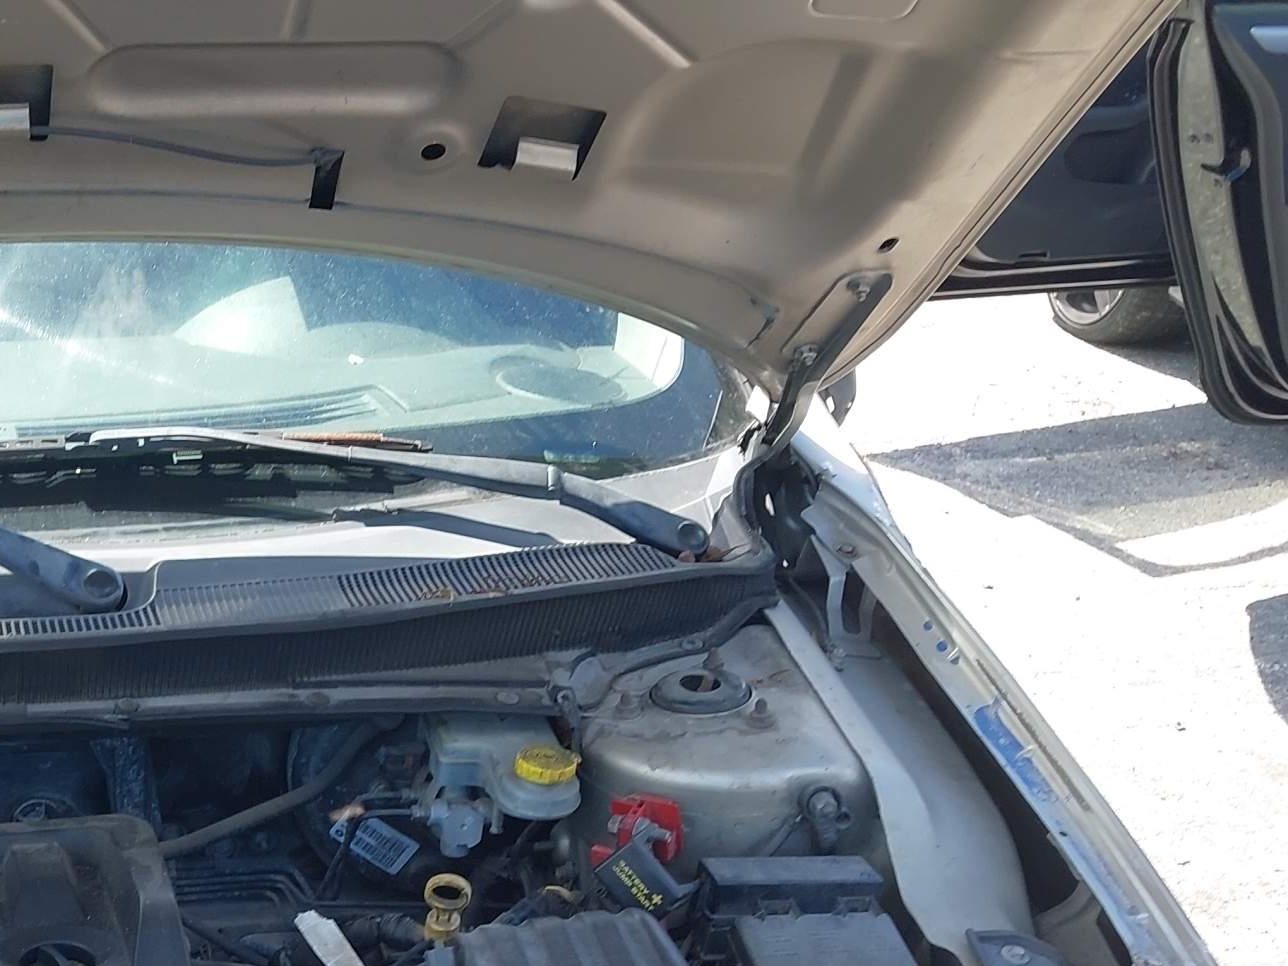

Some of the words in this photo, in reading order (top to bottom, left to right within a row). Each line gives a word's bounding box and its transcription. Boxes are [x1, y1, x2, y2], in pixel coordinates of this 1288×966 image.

[612, 864, 633, 887] JUMP
[631, 886, 655, 912] START
[618, 860, 650, 894] BATTERY
